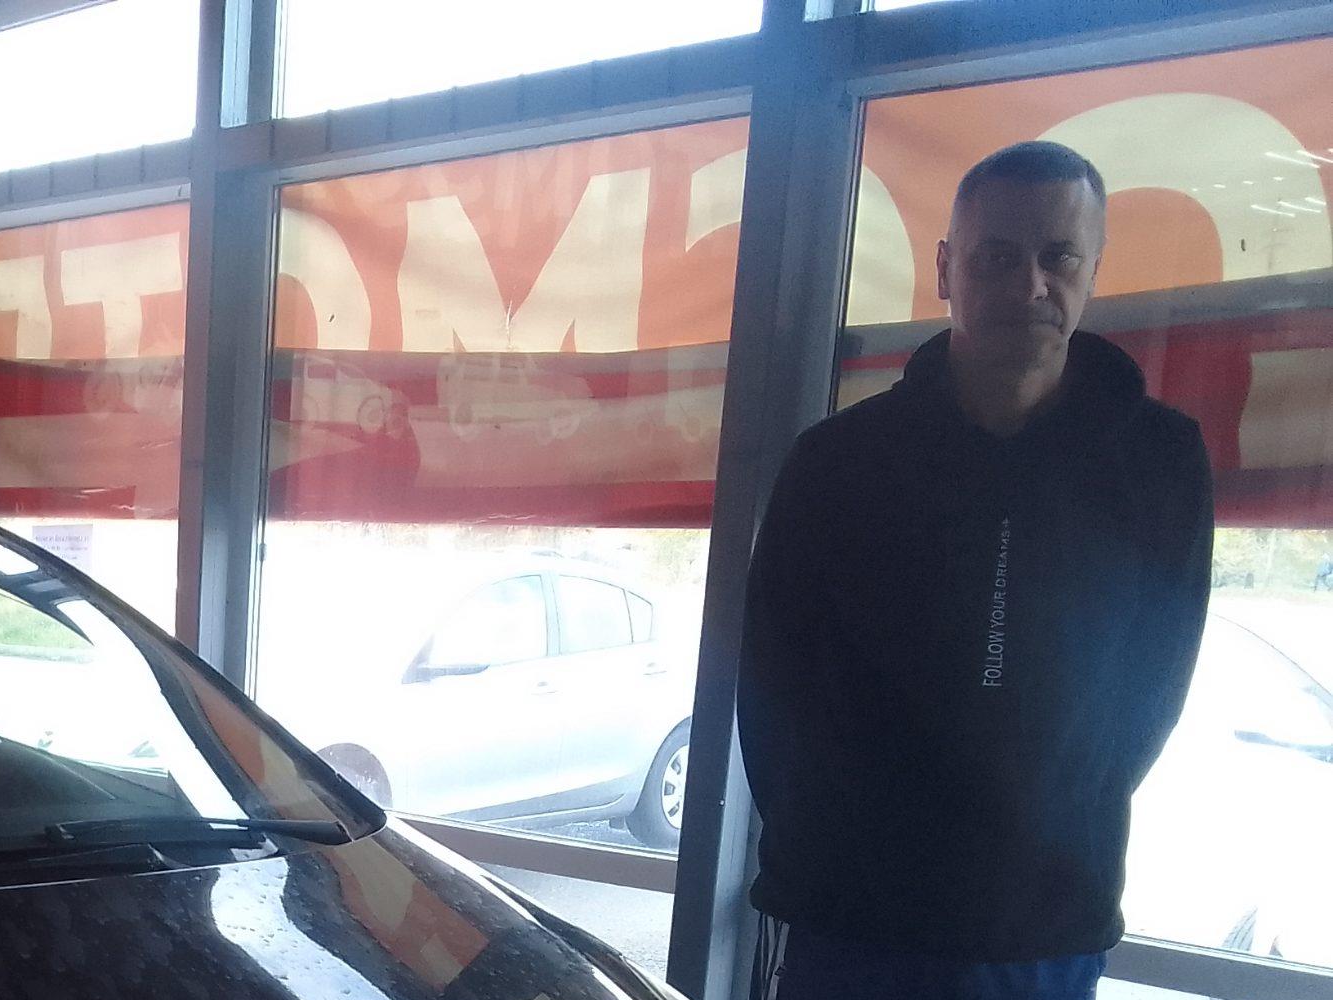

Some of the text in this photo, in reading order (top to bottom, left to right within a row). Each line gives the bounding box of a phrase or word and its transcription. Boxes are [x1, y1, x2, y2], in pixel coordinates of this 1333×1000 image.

[982, 529, 1010, 688] FOLLOW YOUR DREAMS
